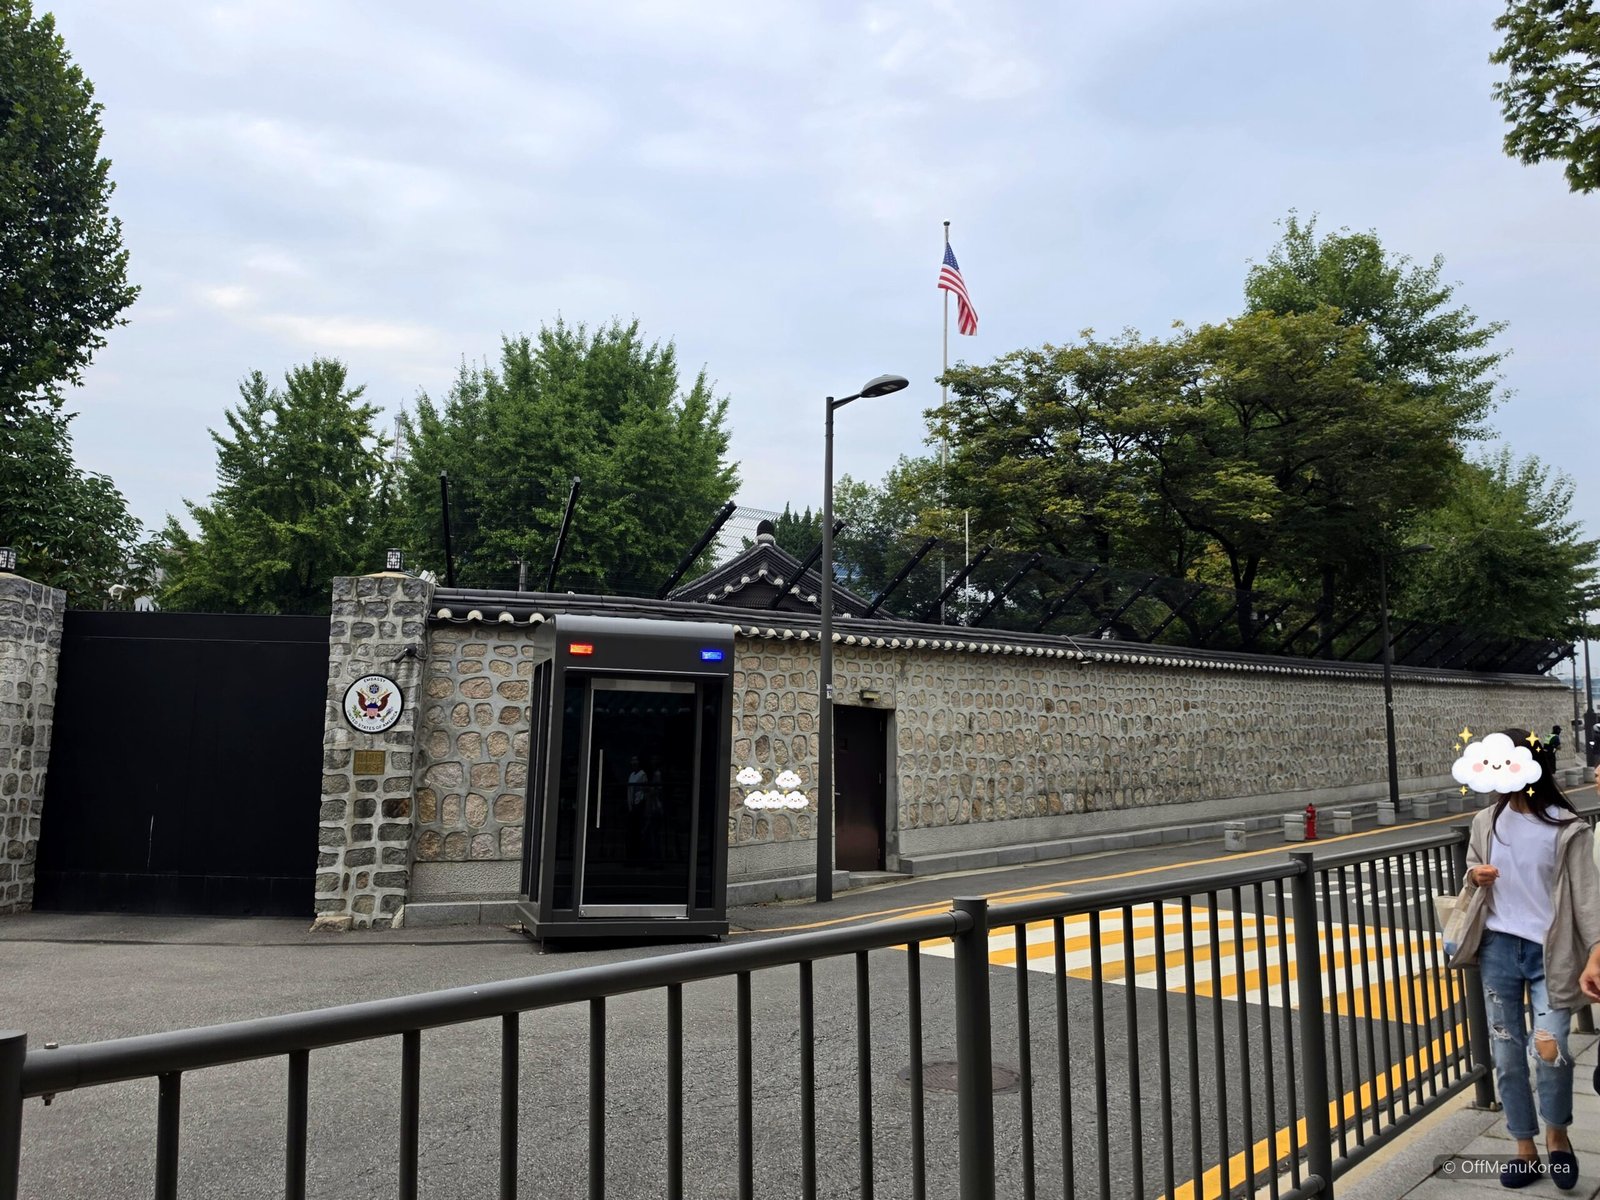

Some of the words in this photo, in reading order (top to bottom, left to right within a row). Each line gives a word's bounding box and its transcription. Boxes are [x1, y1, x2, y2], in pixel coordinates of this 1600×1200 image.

[347, 709, 359, 725] UNITED
[358, 723, 375, 731] STATES
[382, 710, 398, 727] AMERICA
